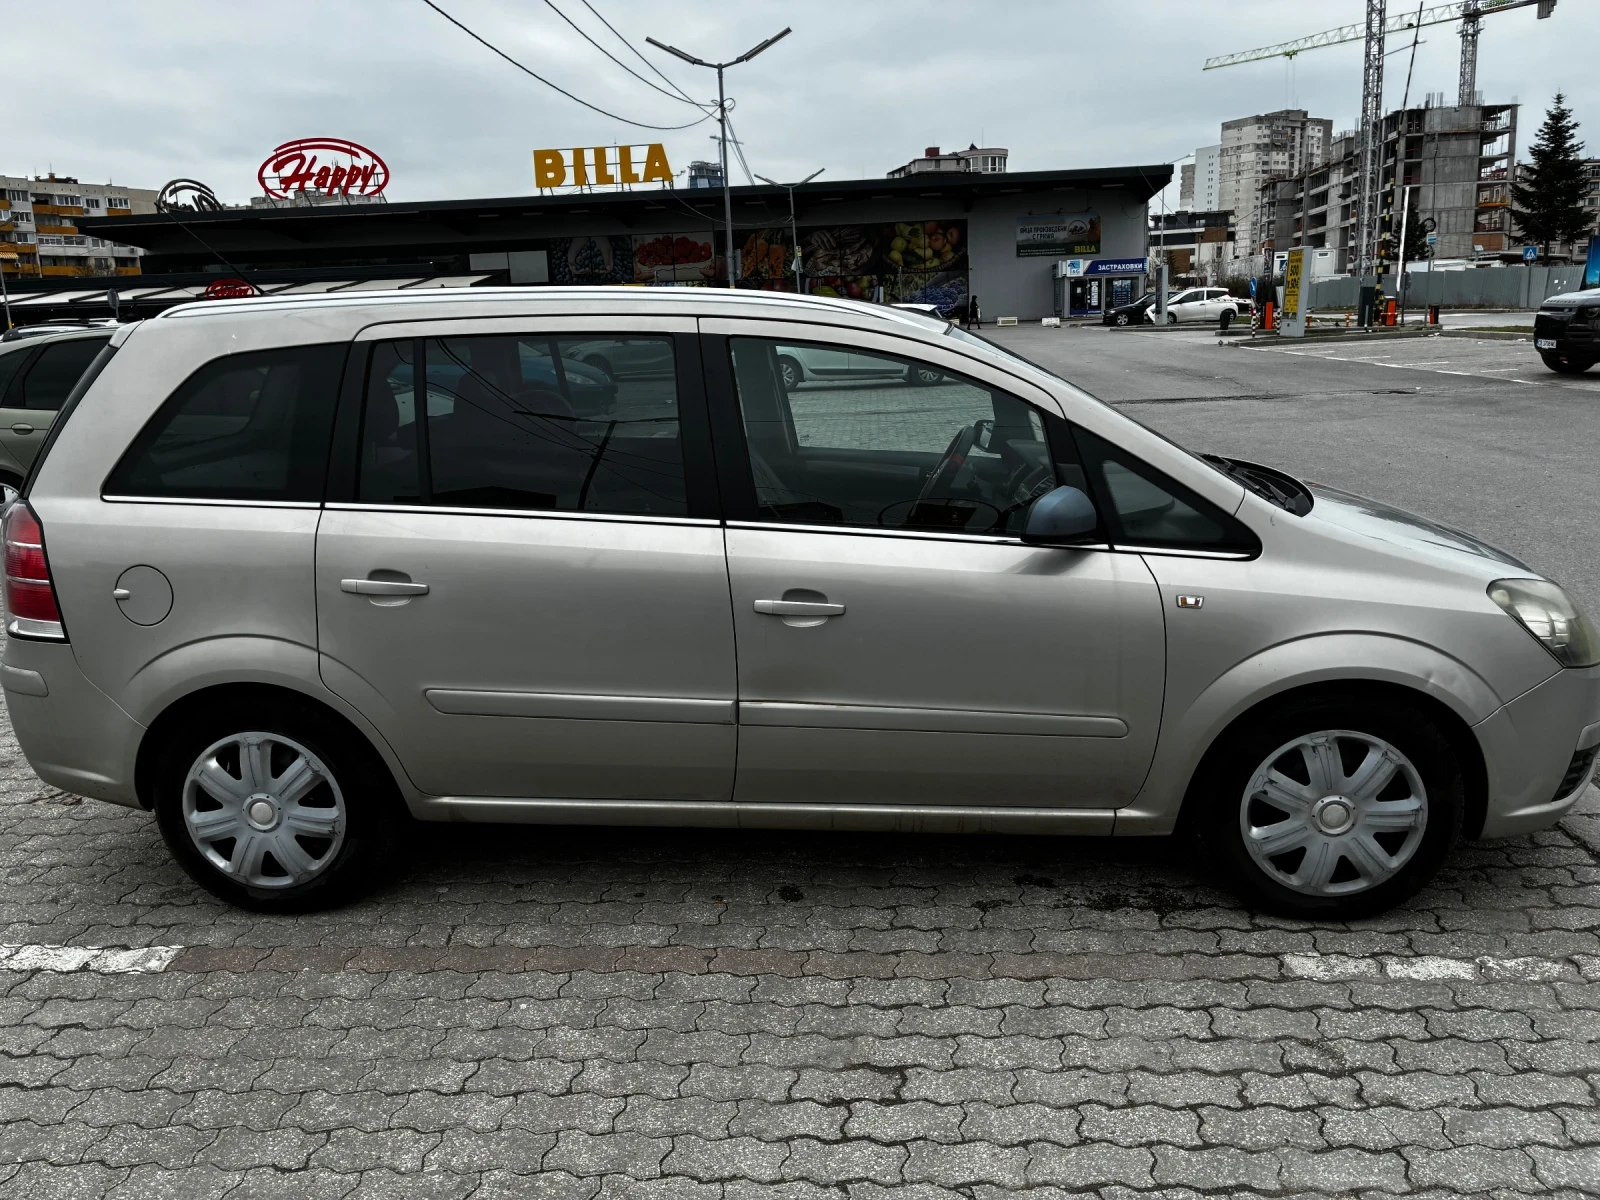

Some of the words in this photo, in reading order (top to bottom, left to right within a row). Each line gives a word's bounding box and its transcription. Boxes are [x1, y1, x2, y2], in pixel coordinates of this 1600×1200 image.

[272, 153, 377, 196] Happy
[533, 143, 674, 188] BILLA
[1074, 245, 1096, 253] BILLA
[1098, 263, 1142, 271] ЗАСТРАХОВКИ
